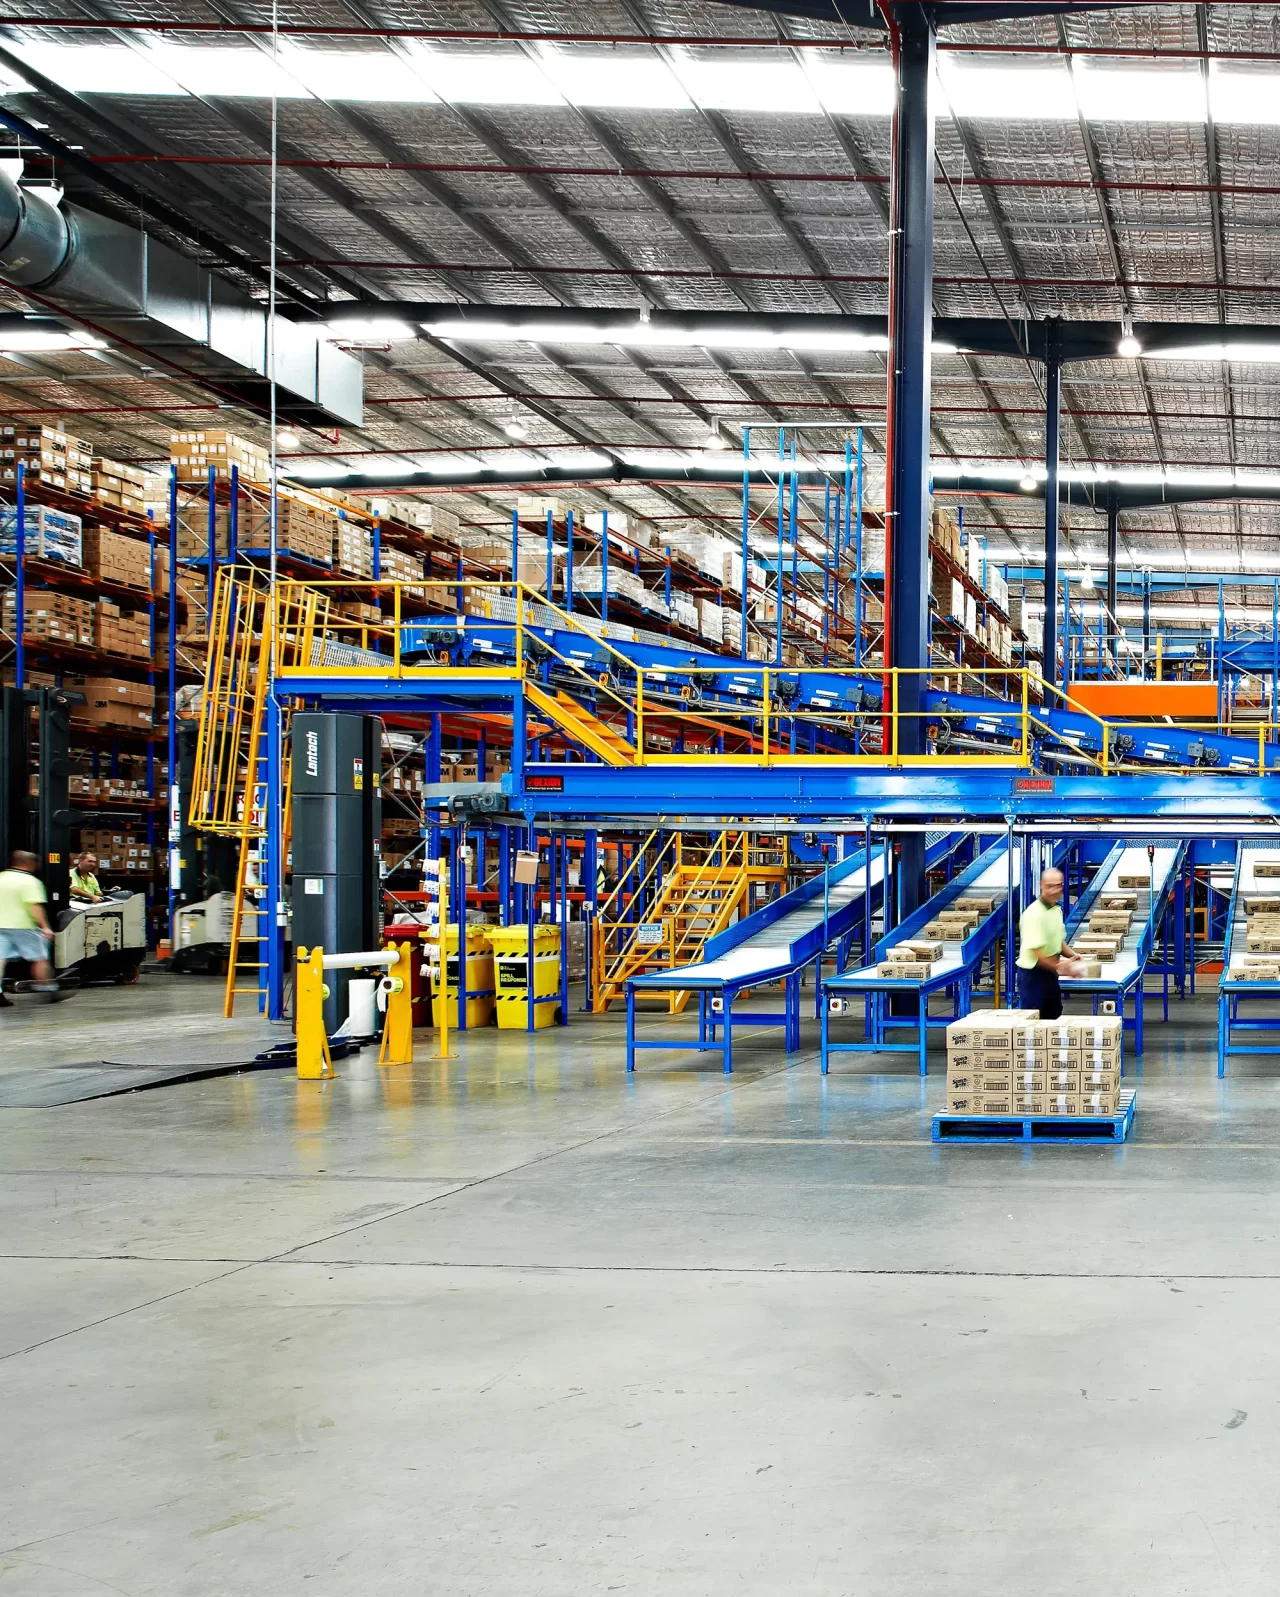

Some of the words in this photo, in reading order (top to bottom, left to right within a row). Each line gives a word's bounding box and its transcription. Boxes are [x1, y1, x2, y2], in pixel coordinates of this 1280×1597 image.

[52, 442, 66, 454] 3M
[95, 701, 107, 709] 3M
[306, 730, 318, 777] Lantech
[463, 768, 476, 776] 3M
[487, 865, 499, 873] 3M
